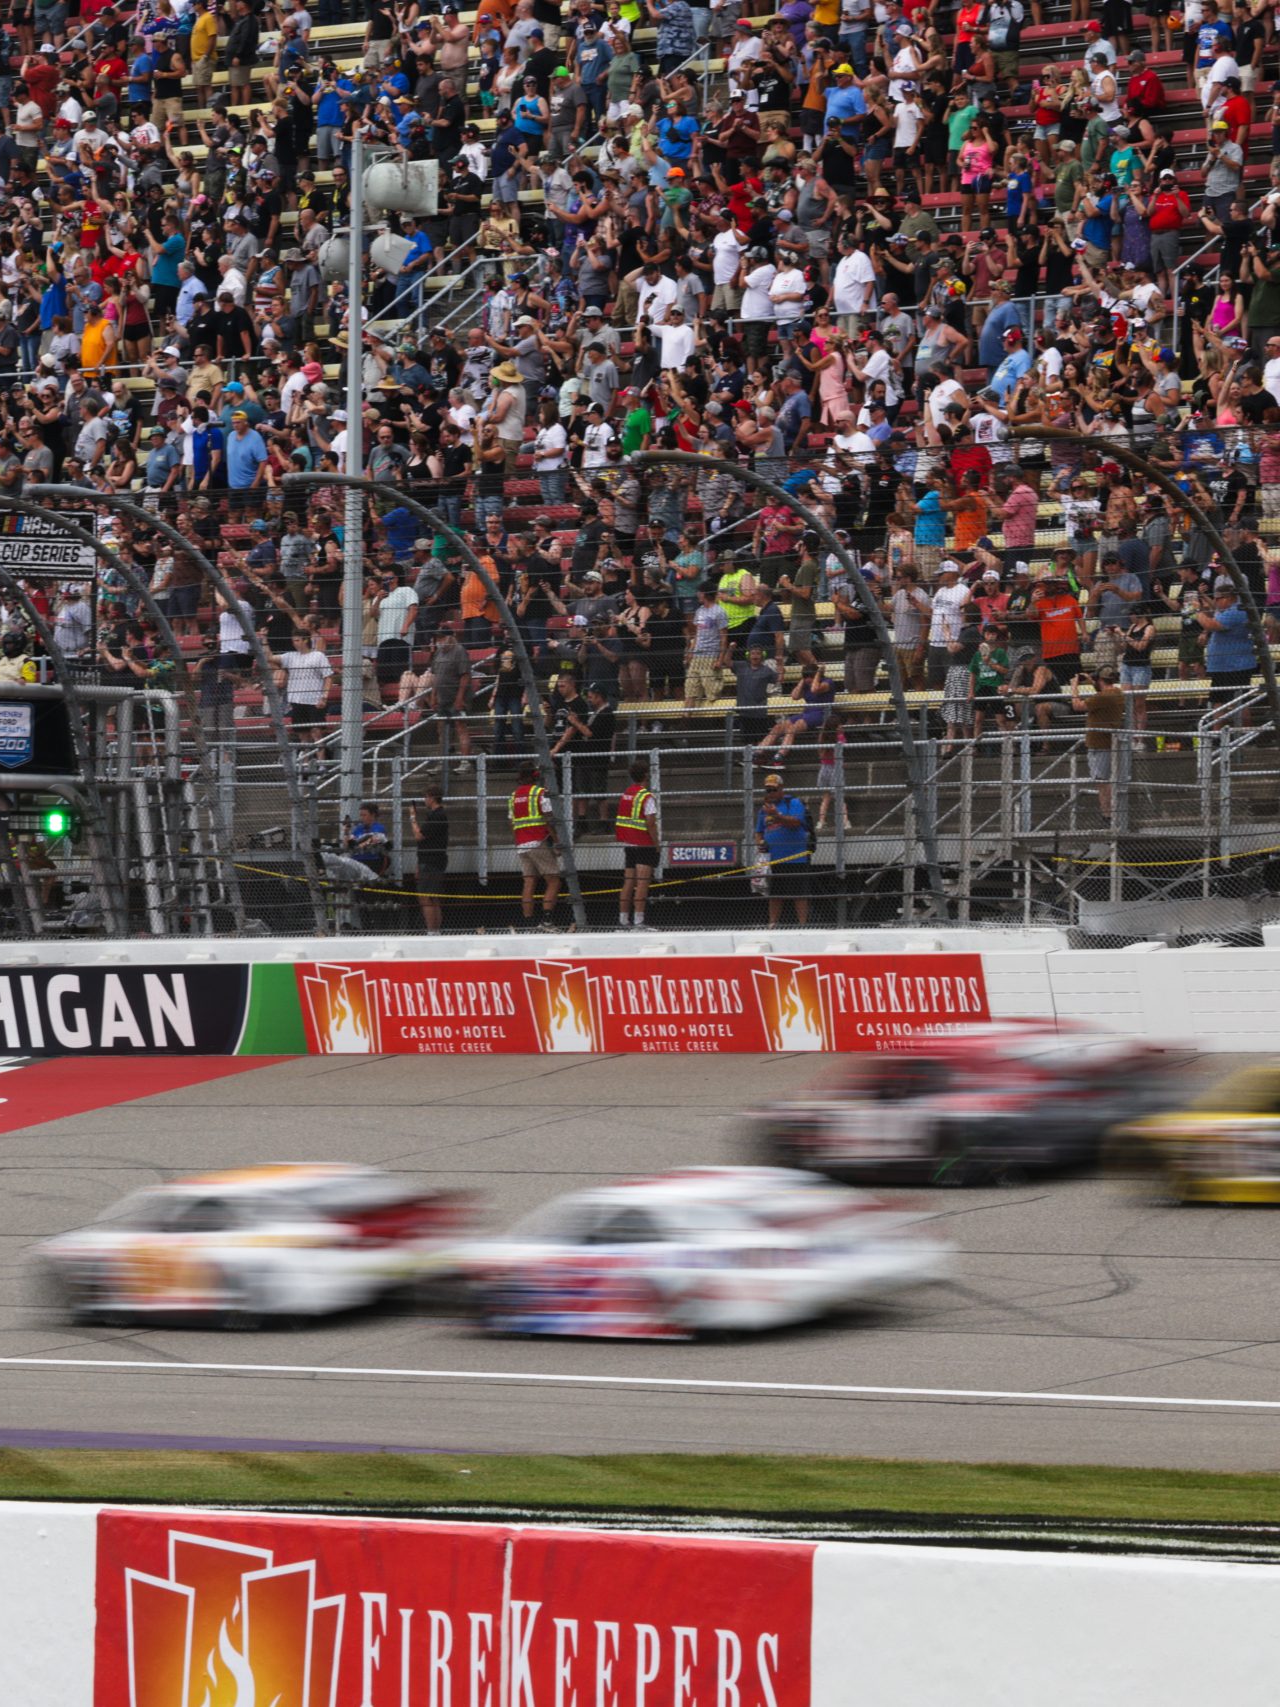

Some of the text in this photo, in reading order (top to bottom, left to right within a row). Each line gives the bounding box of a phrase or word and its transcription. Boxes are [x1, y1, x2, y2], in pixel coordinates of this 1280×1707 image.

[1, 543, 81, 562] CUP SERIES
[672, 847, 728, 860] SECTION 2
[400, 1025, 506, 1039] CASINO HOTEL
[624, 1024, 734, 1037] CASINO HOTEL
[856, 1022, 913, 1036] CASINO
[418, 1042, 493, 1053] BATTLE CREEK
[641, 1041, 720, 1051] BATTLE CREEK
